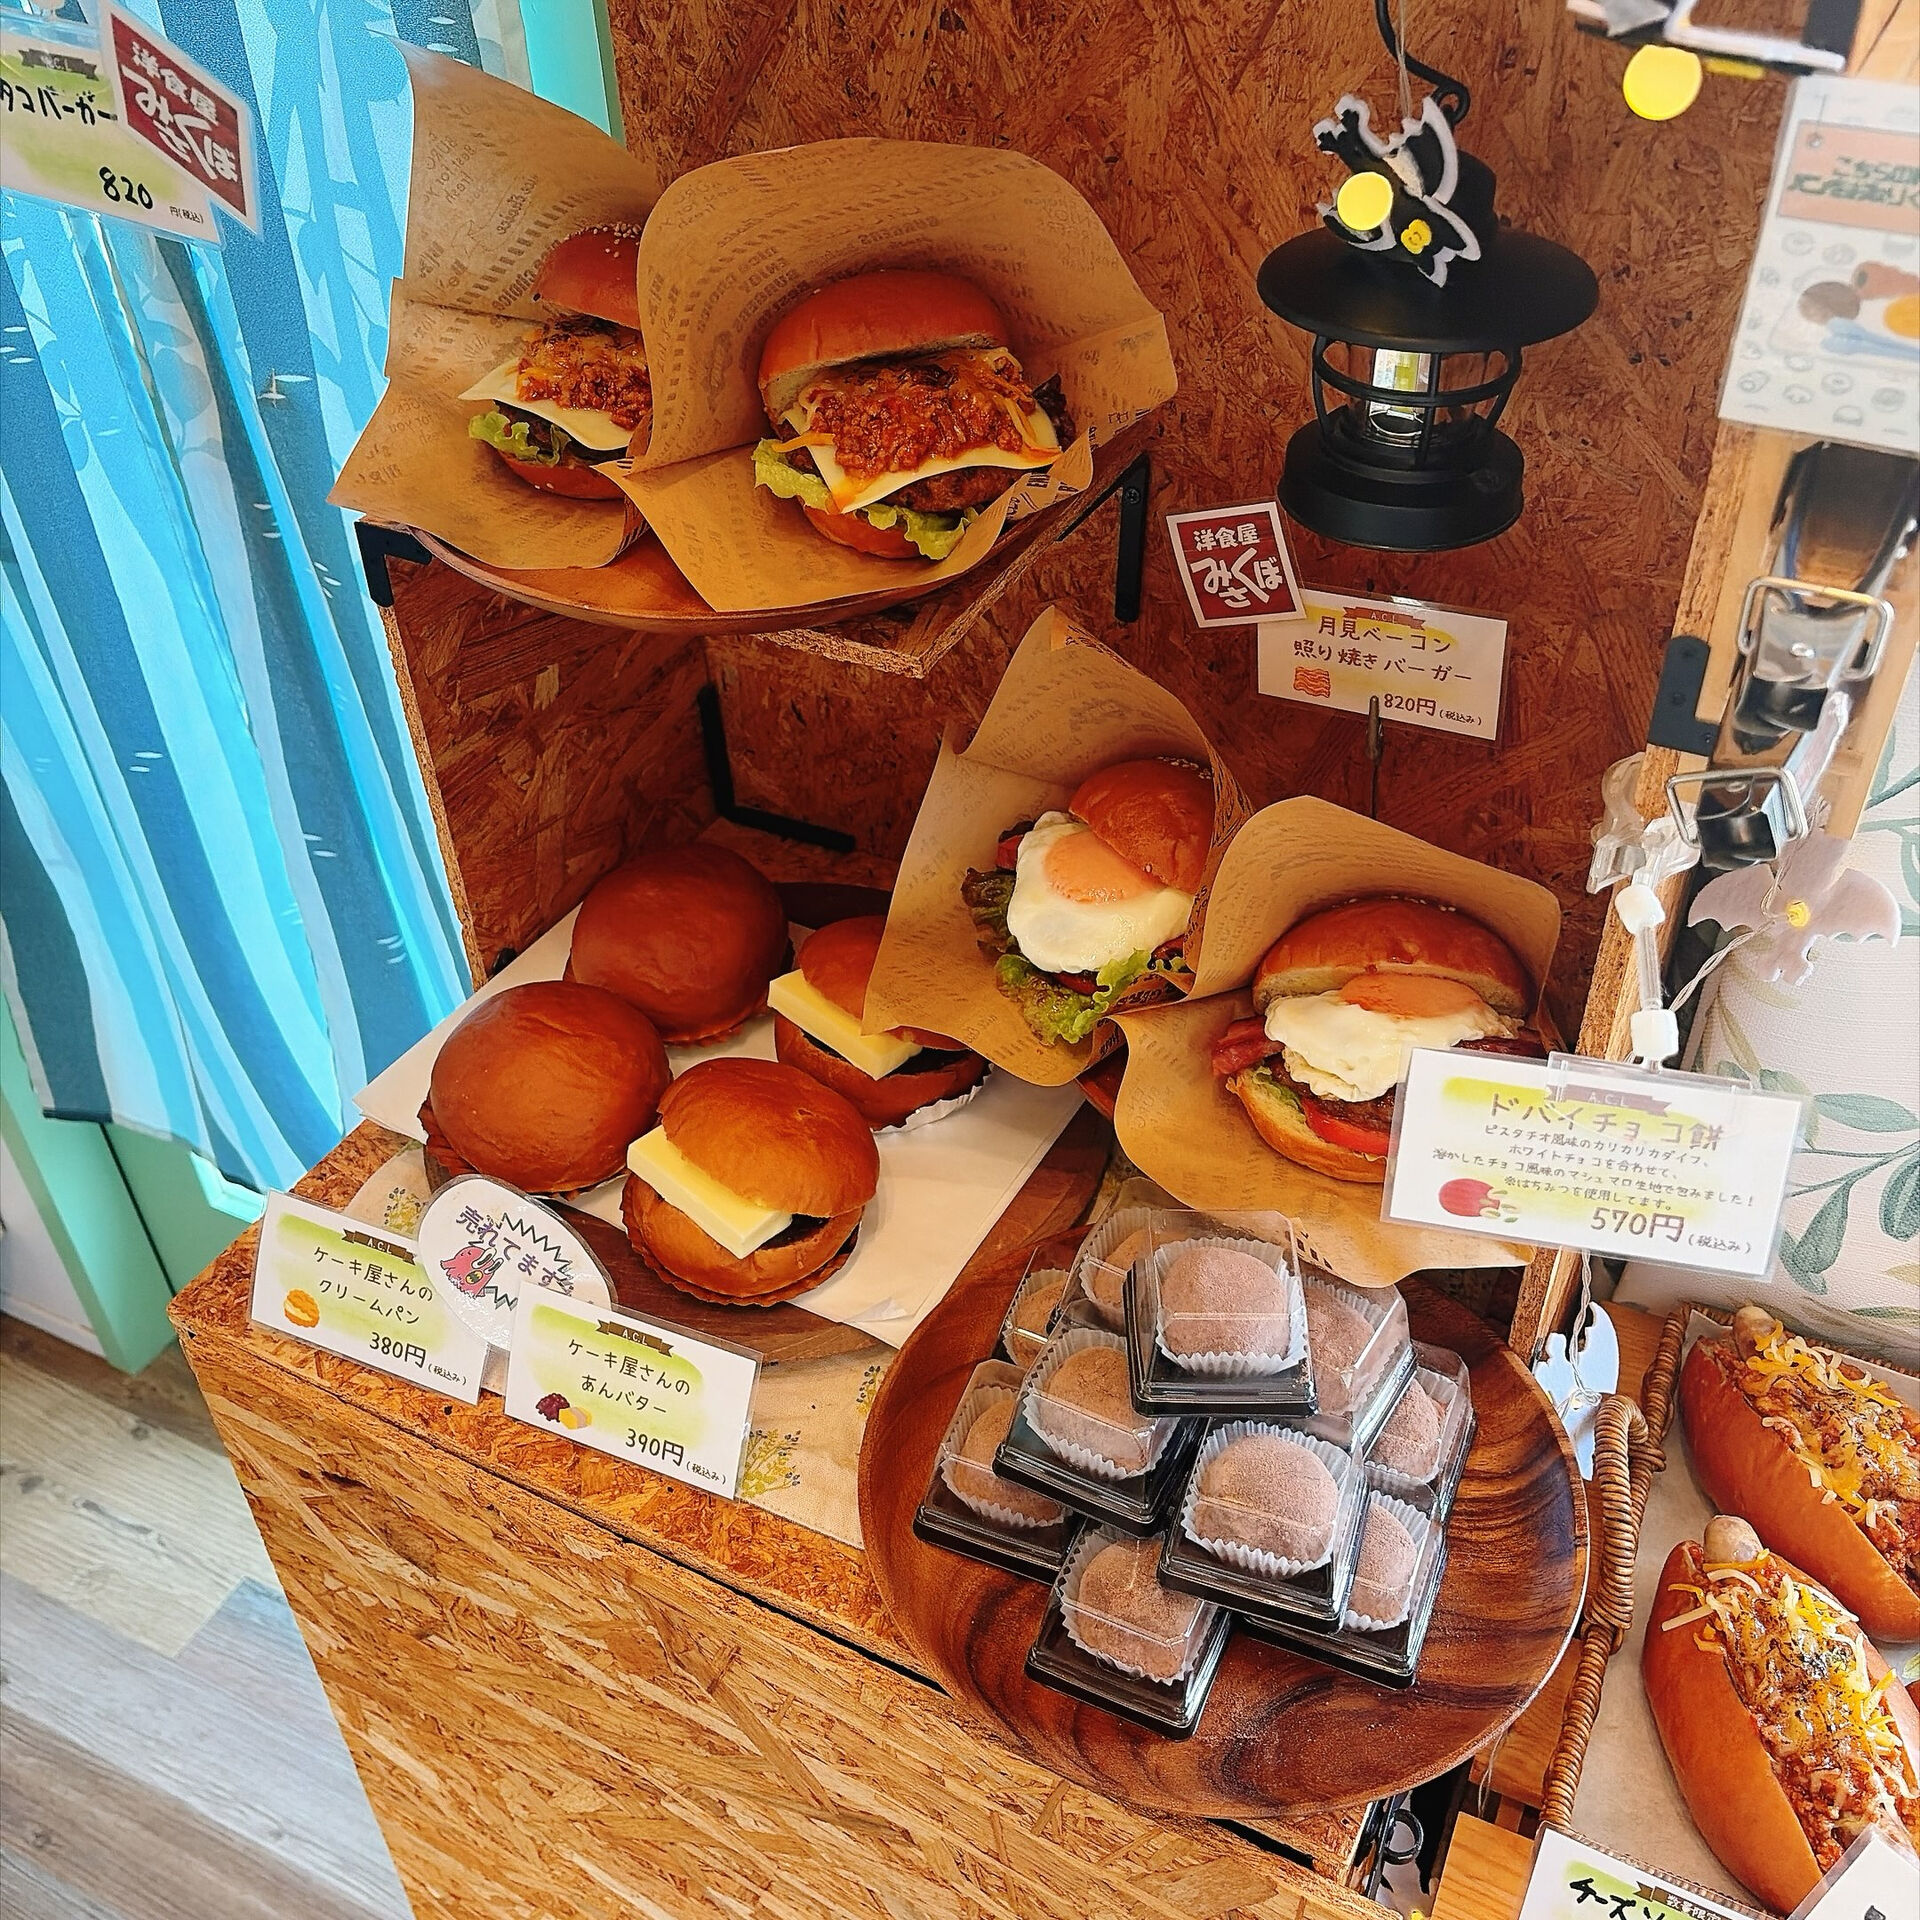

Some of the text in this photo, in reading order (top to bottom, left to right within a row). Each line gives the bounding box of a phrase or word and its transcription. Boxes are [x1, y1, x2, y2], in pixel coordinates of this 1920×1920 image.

[132, 42, 219, 126] 洋食屋
[99, 166, 154, 210] 820
[1193, 523, 1260, 552] 洋食屋
[1318, 616, 1452, 654] 月見ベーコン
[1294, 639, 1473, 683] 照り焼きバーガー
[1384, 693, 1437, 717] 820円
[1490, 1093, 1724, 1151] ドバイチョコ餅
[1590, 1207, 1685, 1243] 570円
[313, 1246, 434, 1303] ケーキ屋さんの
[319, 1279, 420, 1325] クリームパン
[369, 1331, 427, 1369] 380円
[568, 1339, 691, 1396] ケーキ屋さんの
[581, 1374, 668, 1415] あんバター
[624, 1427, 685, 1467] 390円
